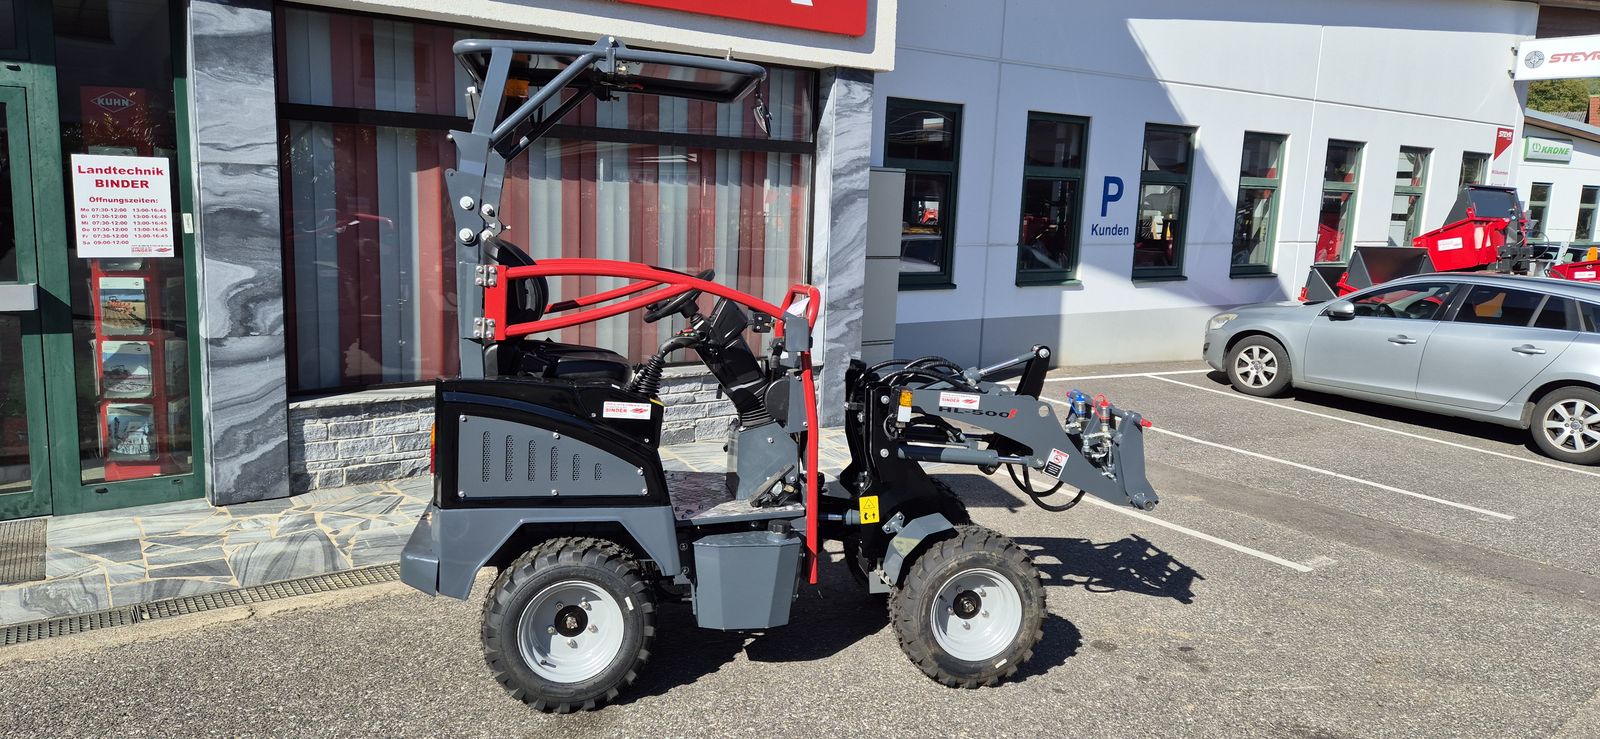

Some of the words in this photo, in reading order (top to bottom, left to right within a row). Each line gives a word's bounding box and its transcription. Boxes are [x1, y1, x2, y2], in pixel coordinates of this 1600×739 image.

[97, 97, 129, 107] KUHN
[1541, 146, 1570, 155] KRONE
[77, 165, 164, 176] Landtechnik
[95, 179, 149, 189] BINDER
[1101, 176, 1124, 217] P
[1091, 223, 1129, 236] Kunden
